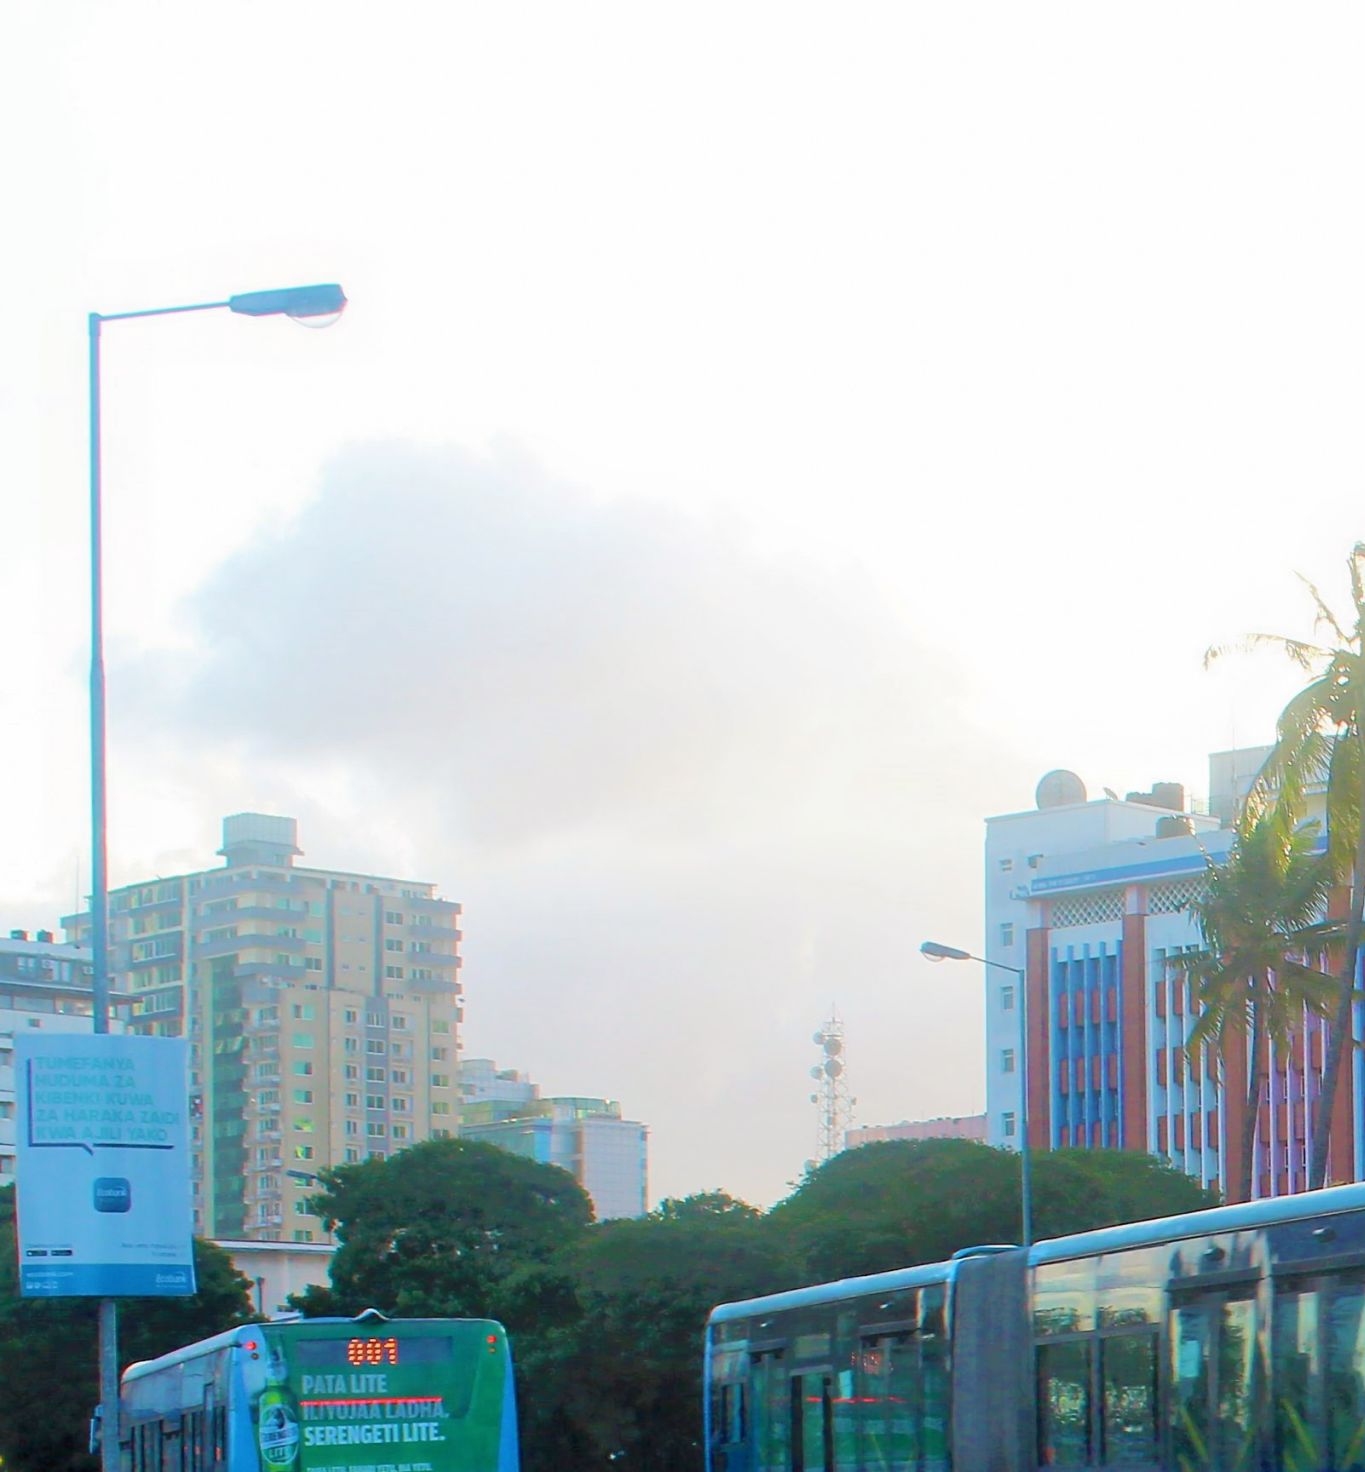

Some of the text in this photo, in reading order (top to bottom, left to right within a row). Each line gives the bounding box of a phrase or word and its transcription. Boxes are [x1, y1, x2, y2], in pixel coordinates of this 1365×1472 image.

[34, 1057, 135, 1070] TUMEFANYA
[34, 1074, 135, 1088] HUDUMA ZA
[34, 1091, 153, 1105] KIBENKI KUWA
[36, 1109, 58, 1122] ZA
[64, 1110, 135, 1122] HARAKA
[35, 1127, 76, 1139] KWA
[128, 1128, 168, 1141] YAKO
[348, 1338, 397, 1365] 001
[303, 1374, 388, 1394] PATA LITE
[304, 1422, 446, 1446] SERENGETI LITE.
